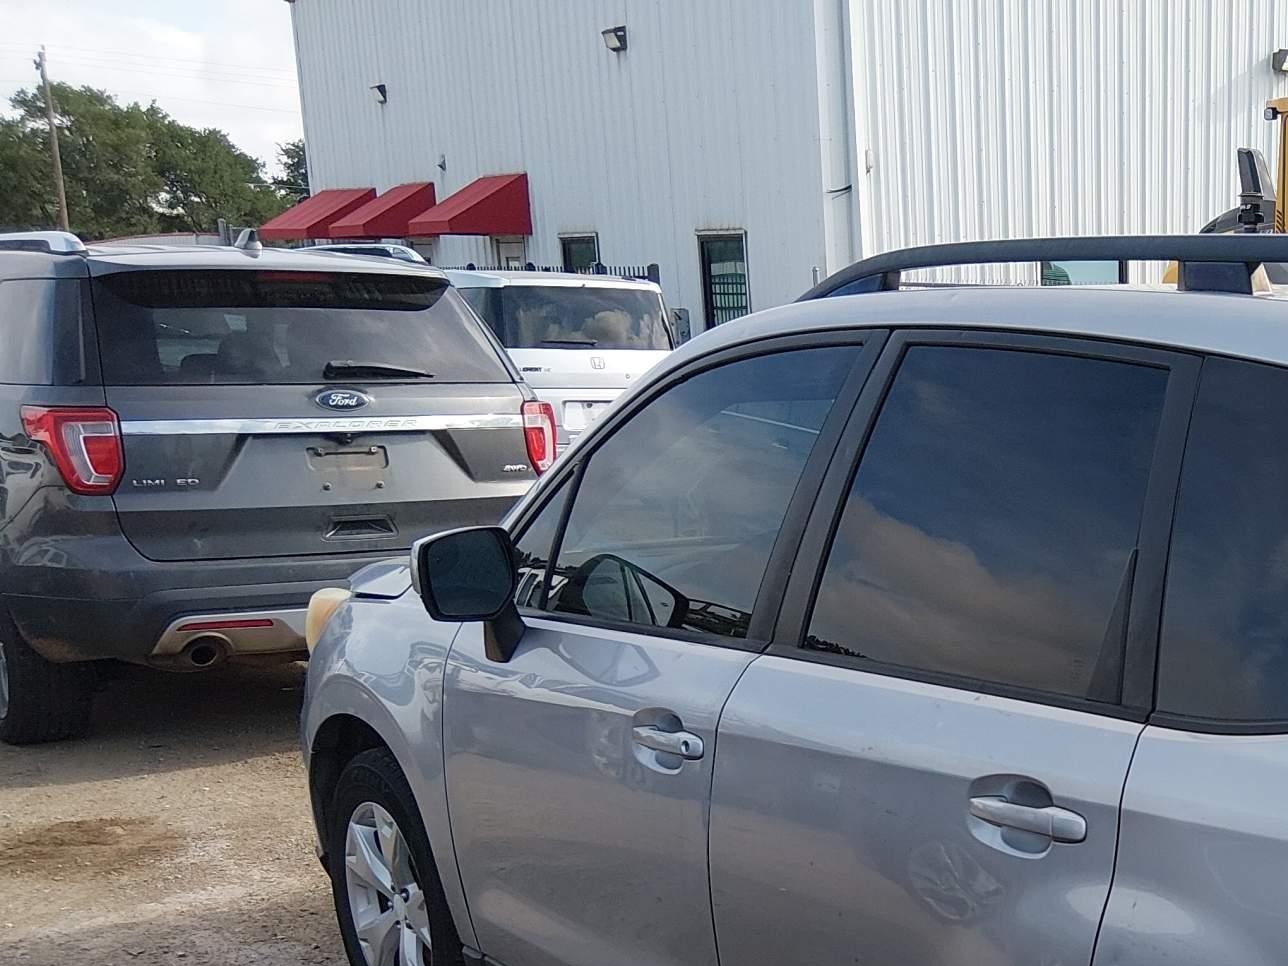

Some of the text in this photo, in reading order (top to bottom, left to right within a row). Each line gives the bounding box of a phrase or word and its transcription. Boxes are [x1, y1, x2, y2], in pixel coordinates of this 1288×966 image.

[329, 393, 358, 406] Ford
[273, 418, 417, 430] EXPLORER
[132, 479, 200, 487] LIMIED
